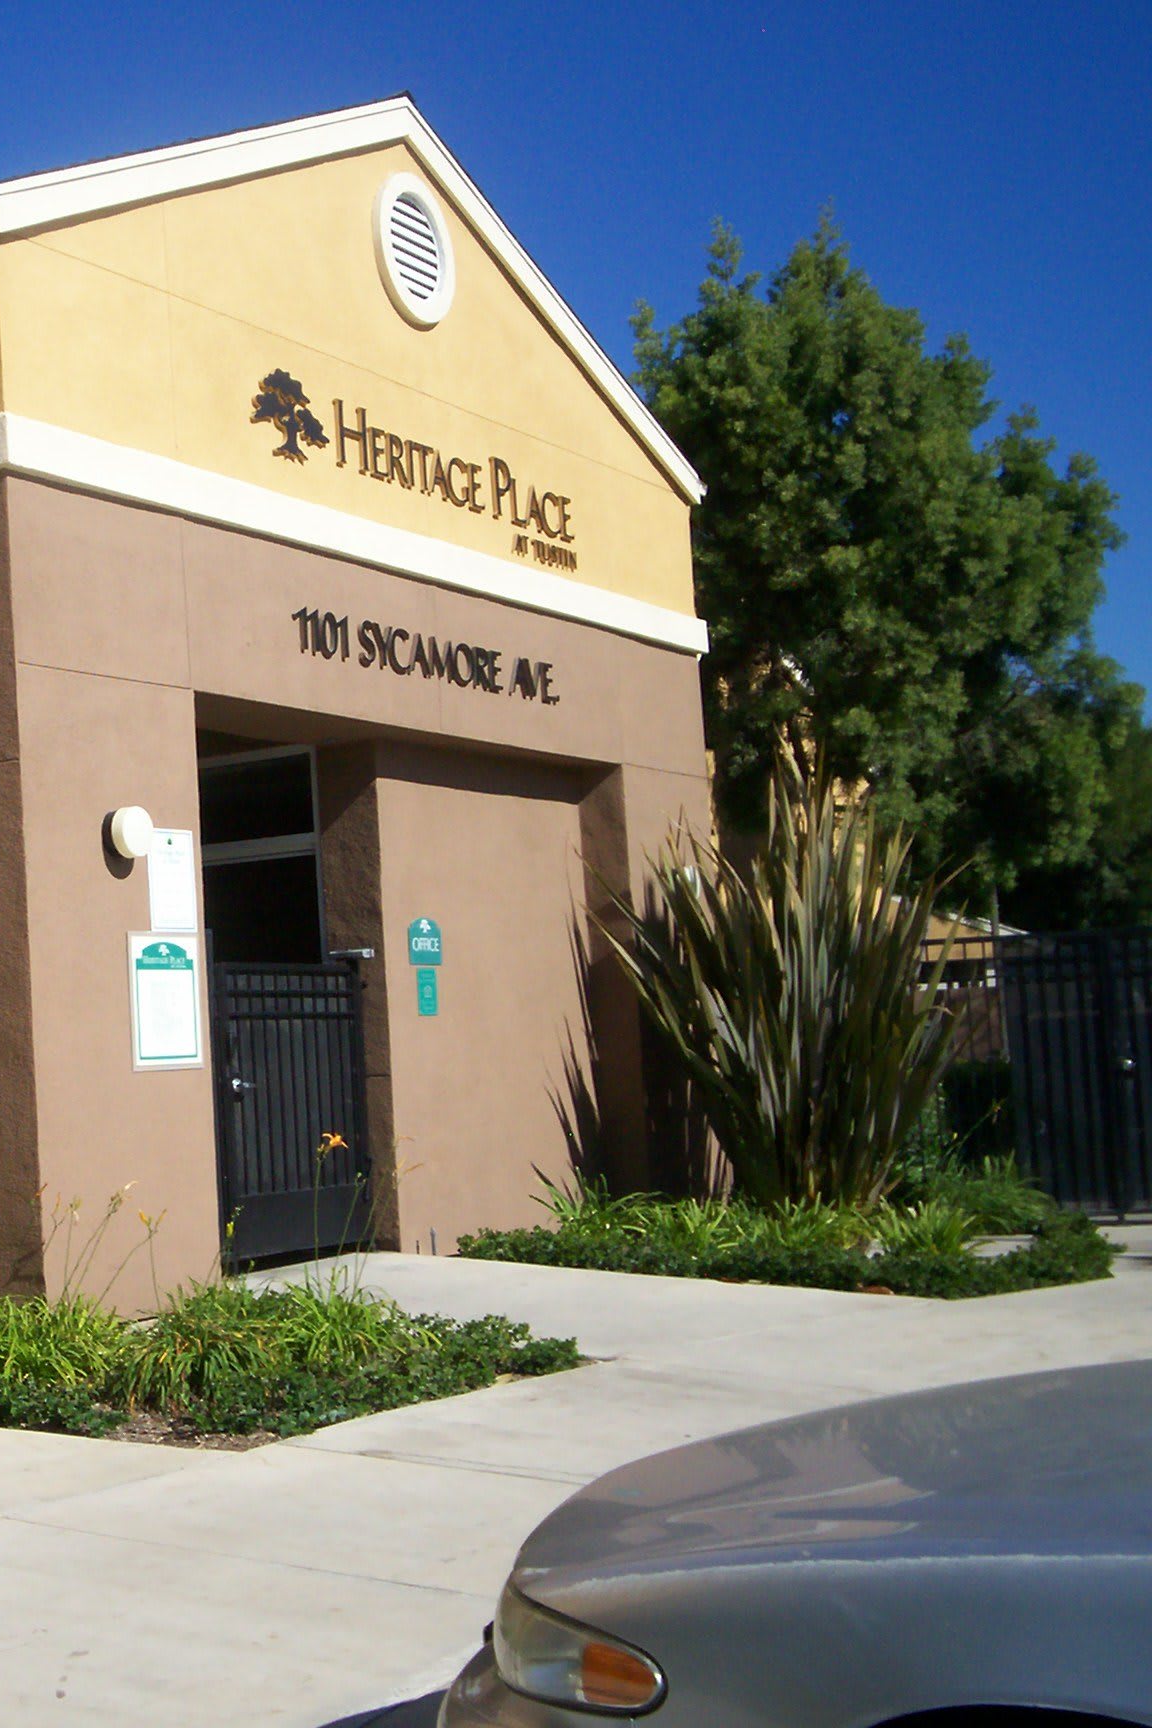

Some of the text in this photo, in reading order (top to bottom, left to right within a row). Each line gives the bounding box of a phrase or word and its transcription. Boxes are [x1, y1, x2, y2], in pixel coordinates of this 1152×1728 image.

[332, 398, 576, 543] HERITAGE PLACE
[511, 533, 578, 572] AT TUSTIN
[291, 606, 350, 662] 1101
[358, 620, 504, 694] SYCAMORE
[412, 936, 440, 952] OFFICE
